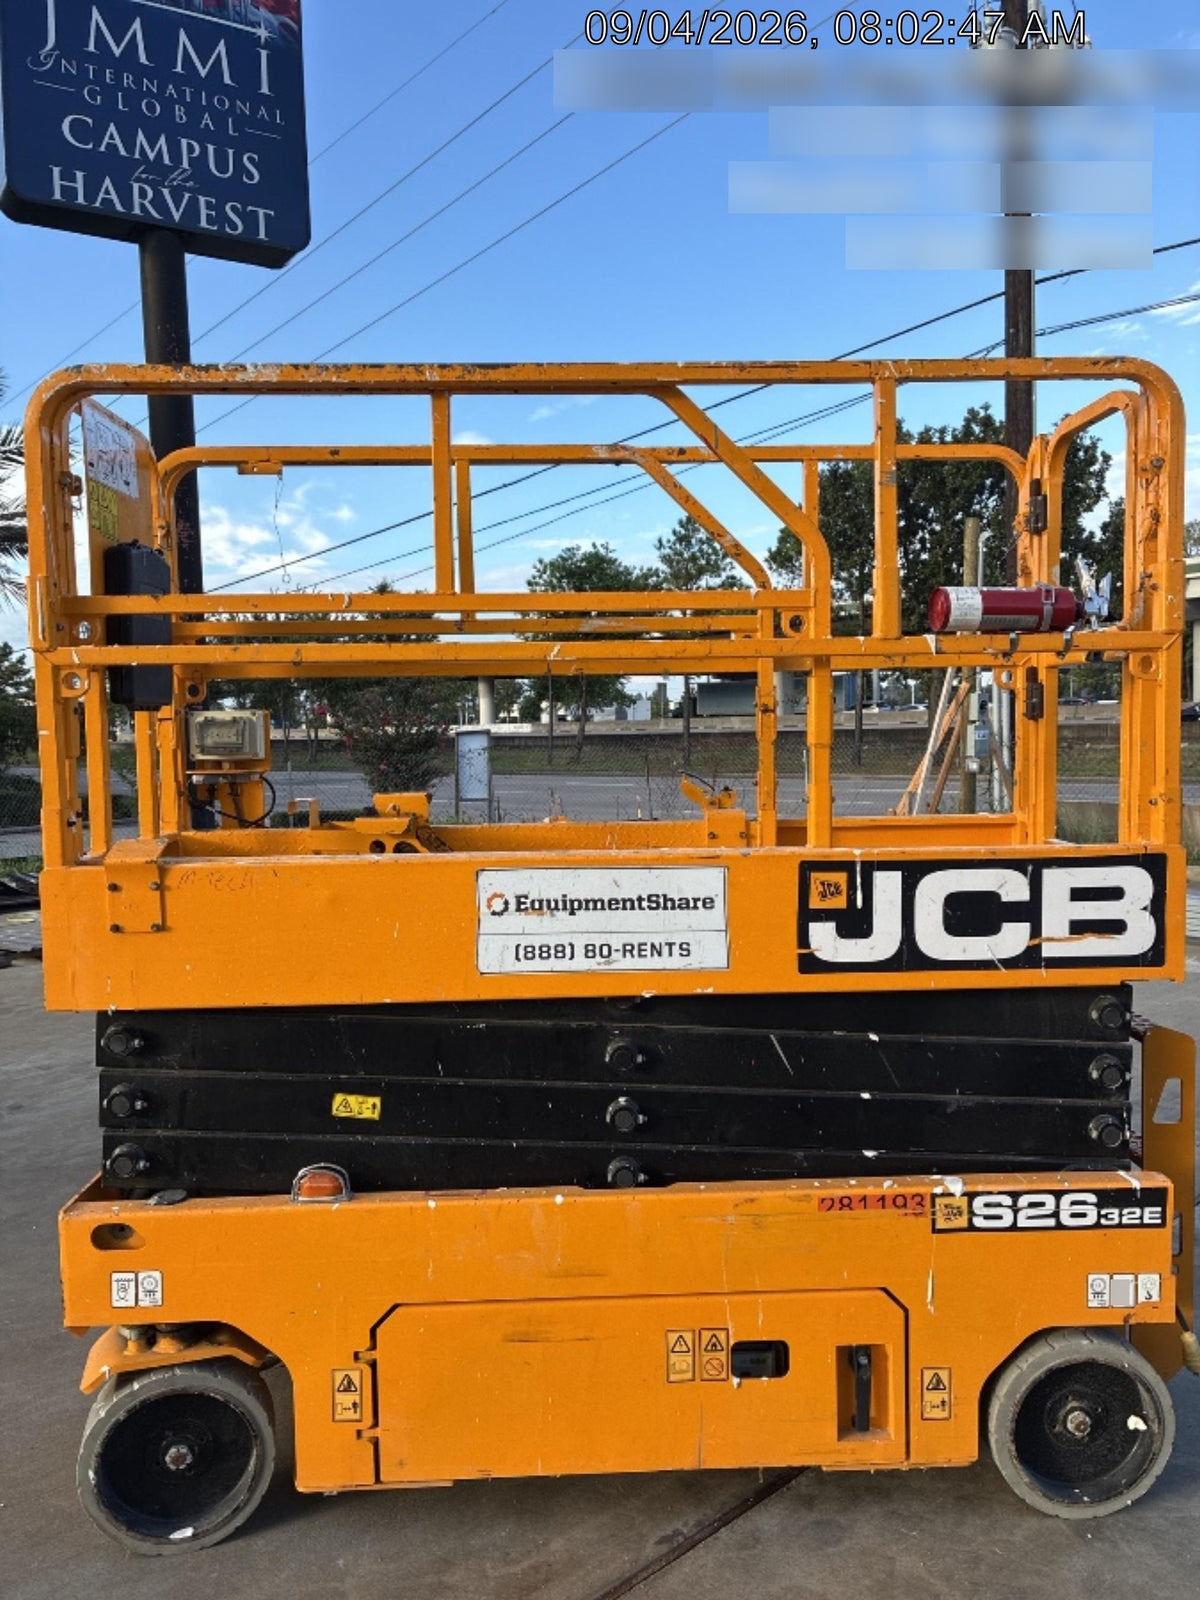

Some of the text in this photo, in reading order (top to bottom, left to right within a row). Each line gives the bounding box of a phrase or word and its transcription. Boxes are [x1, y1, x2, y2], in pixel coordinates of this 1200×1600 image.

[83, 84, 239, 137] GLOBAL
[61, 114, 260, 185] CAMPUS
[48, 164, 275, 241] HARVEST
[513, 893, 715, 915] EquipmentShare
[808, 865, 1156, 963] JCB
[513, 940, 691, 961] (888) 80-RENTS
